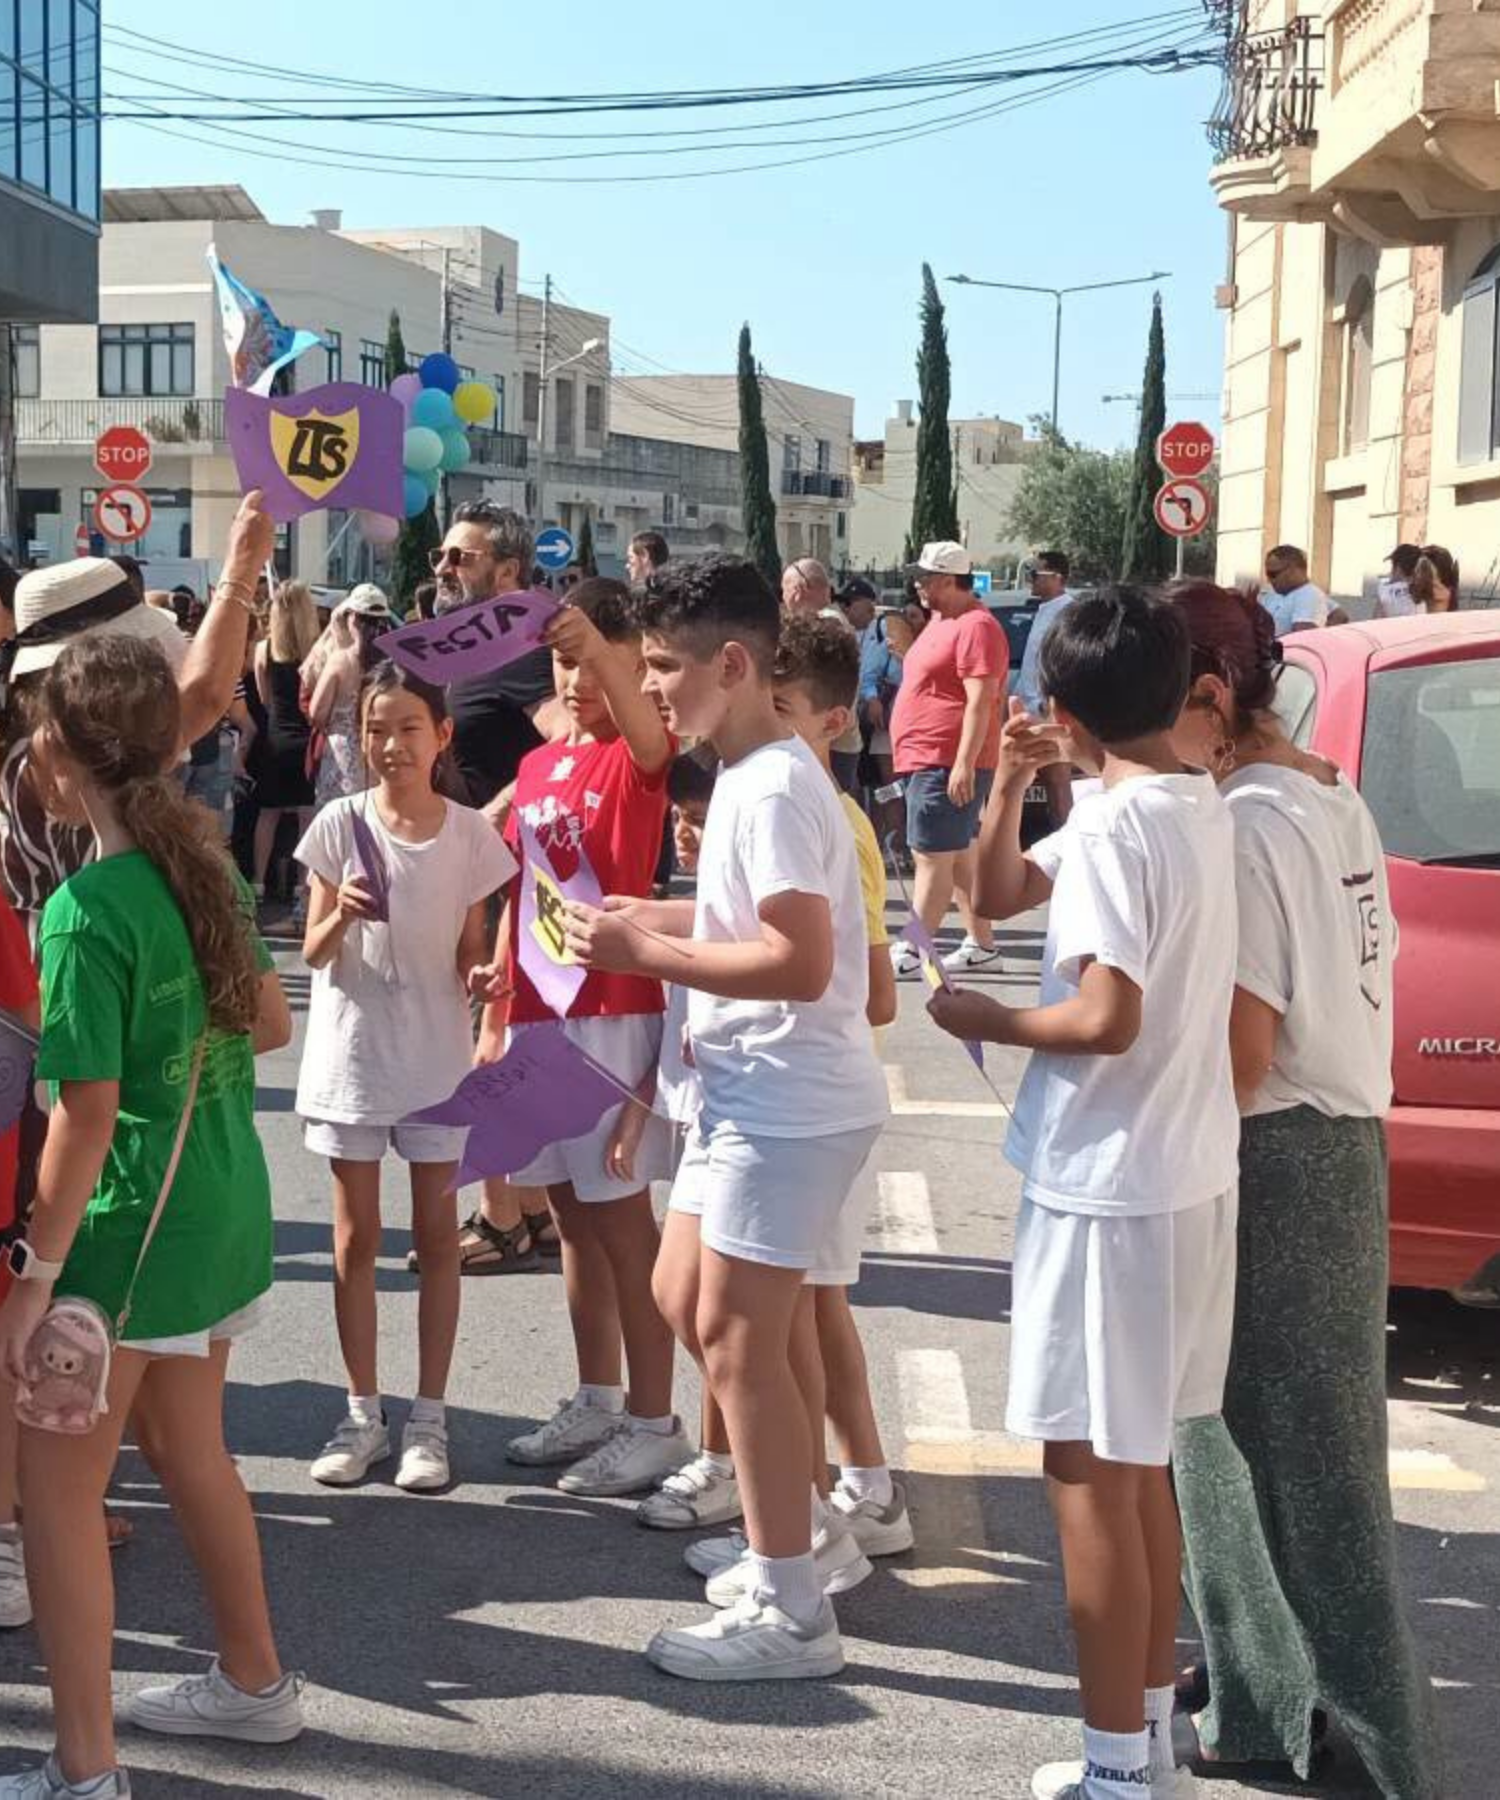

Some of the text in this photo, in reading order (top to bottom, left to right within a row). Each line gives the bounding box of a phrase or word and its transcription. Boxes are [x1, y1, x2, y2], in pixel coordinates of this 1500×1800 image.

[99, 446, 148, 463] STOP
[1163, 442, 1211, 457] STOP
[1418, 1037, 1500, 1054] MICR
